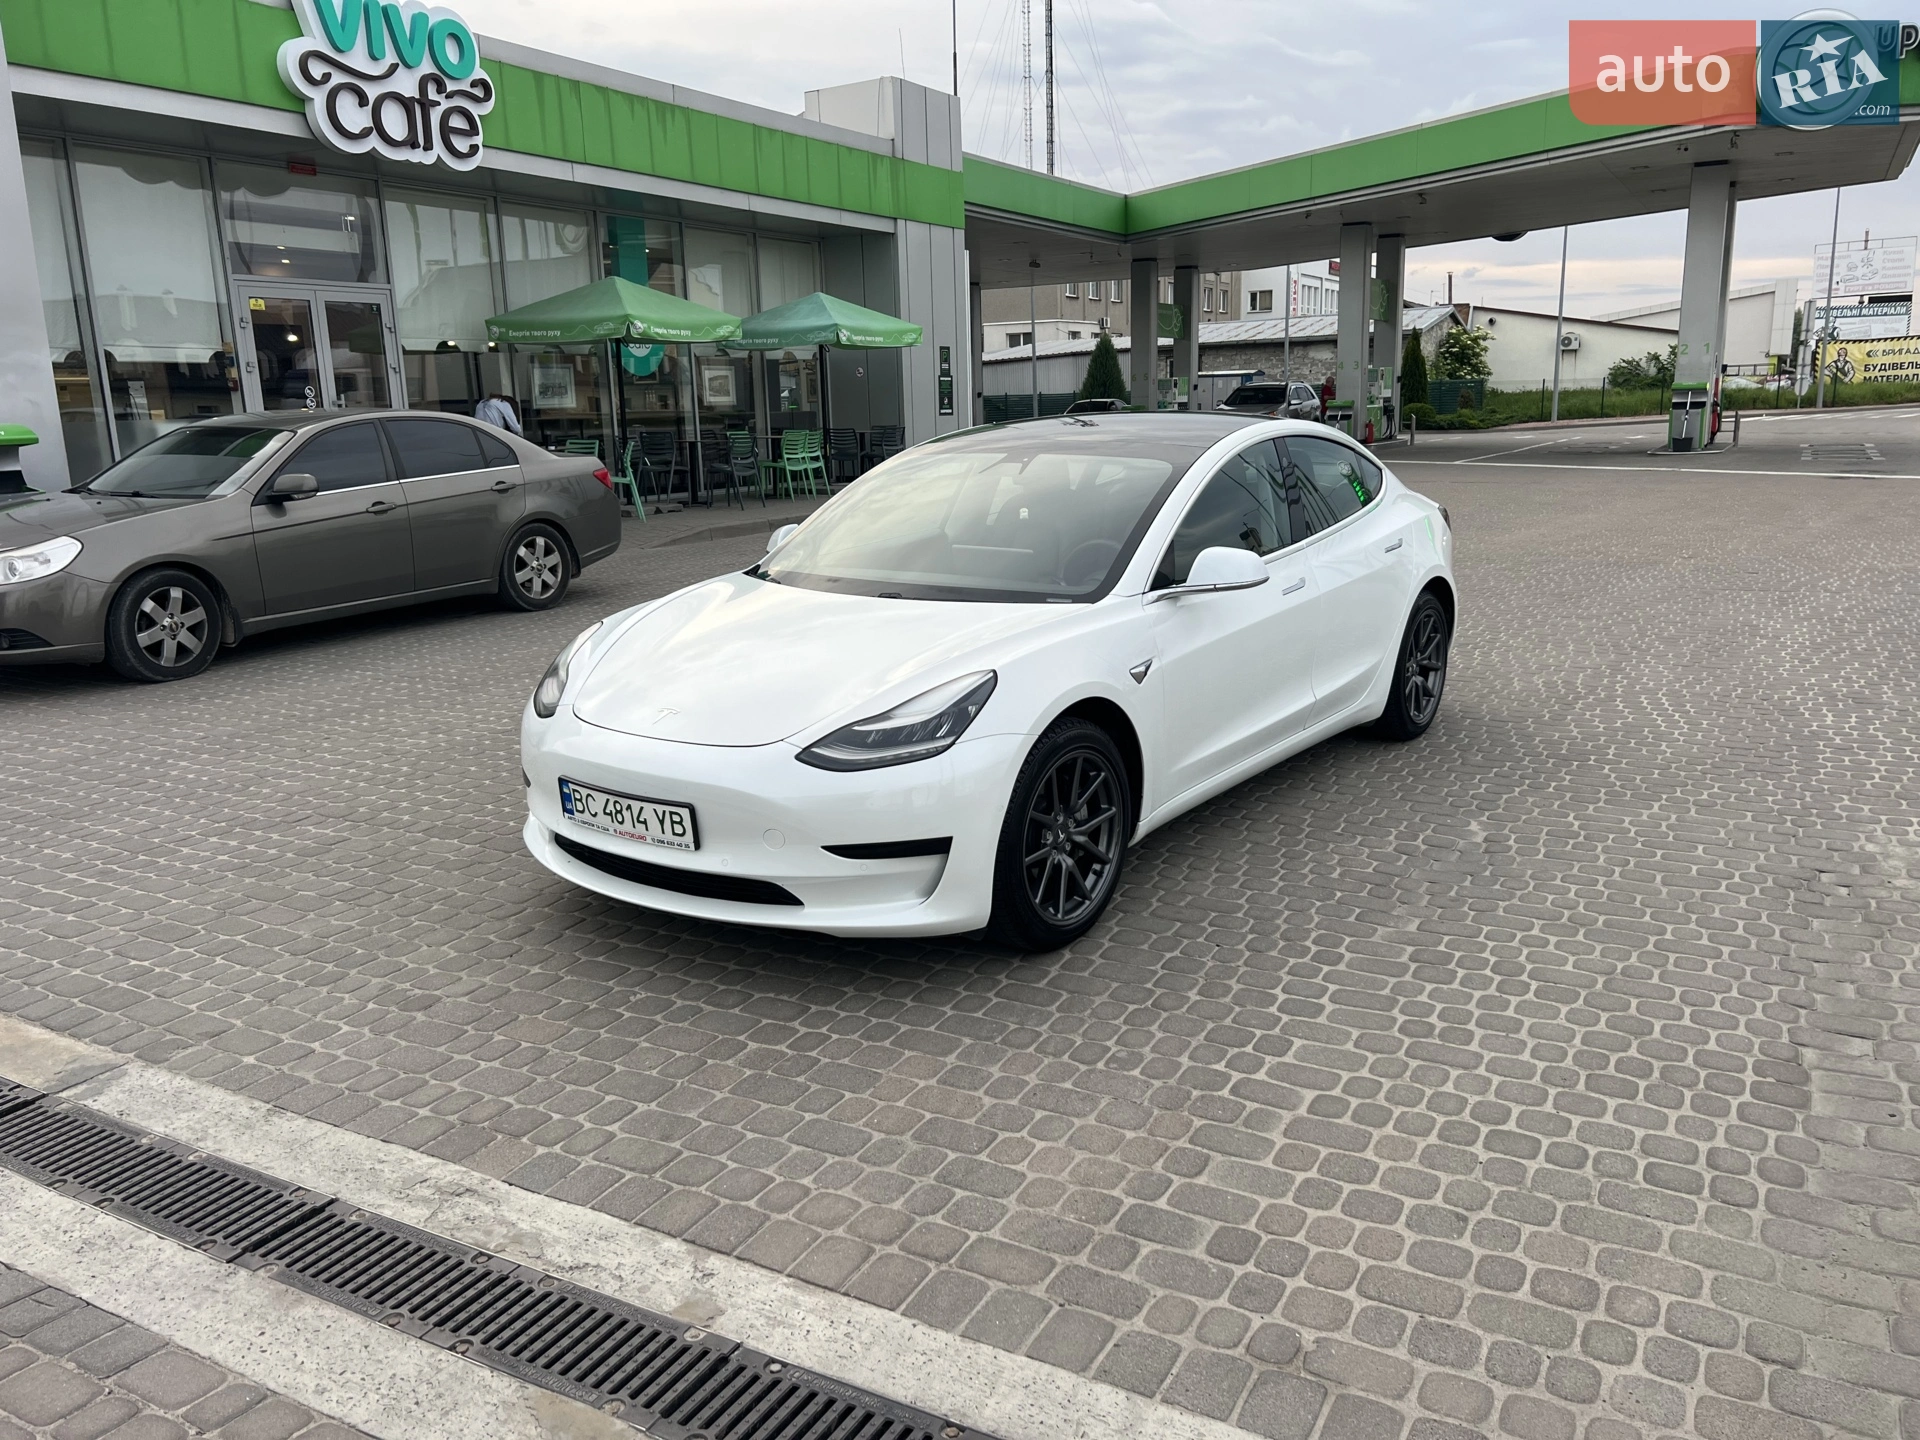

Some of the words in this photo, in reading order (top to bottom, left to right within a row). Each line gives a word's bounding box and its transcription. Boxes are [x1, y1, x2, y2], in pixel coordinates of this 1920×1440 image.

[1815, 308, 1861, 318] БУІВЕЛЬНІ
[1861, 306, 1907, 316] МАТЕРІАЛИ
[1680, 344, 1688, 355] 2
[1704, 342, 1710, 354] 1
[1337, 361, 1344, 370] 4
[1353, 360, 1359, 370] 3
[565, 801, 574, 810] UA
[571, 788, 598, 818] BC
[602, 798, 649, 832] 4814
[653, 808, 687, 837] YB
